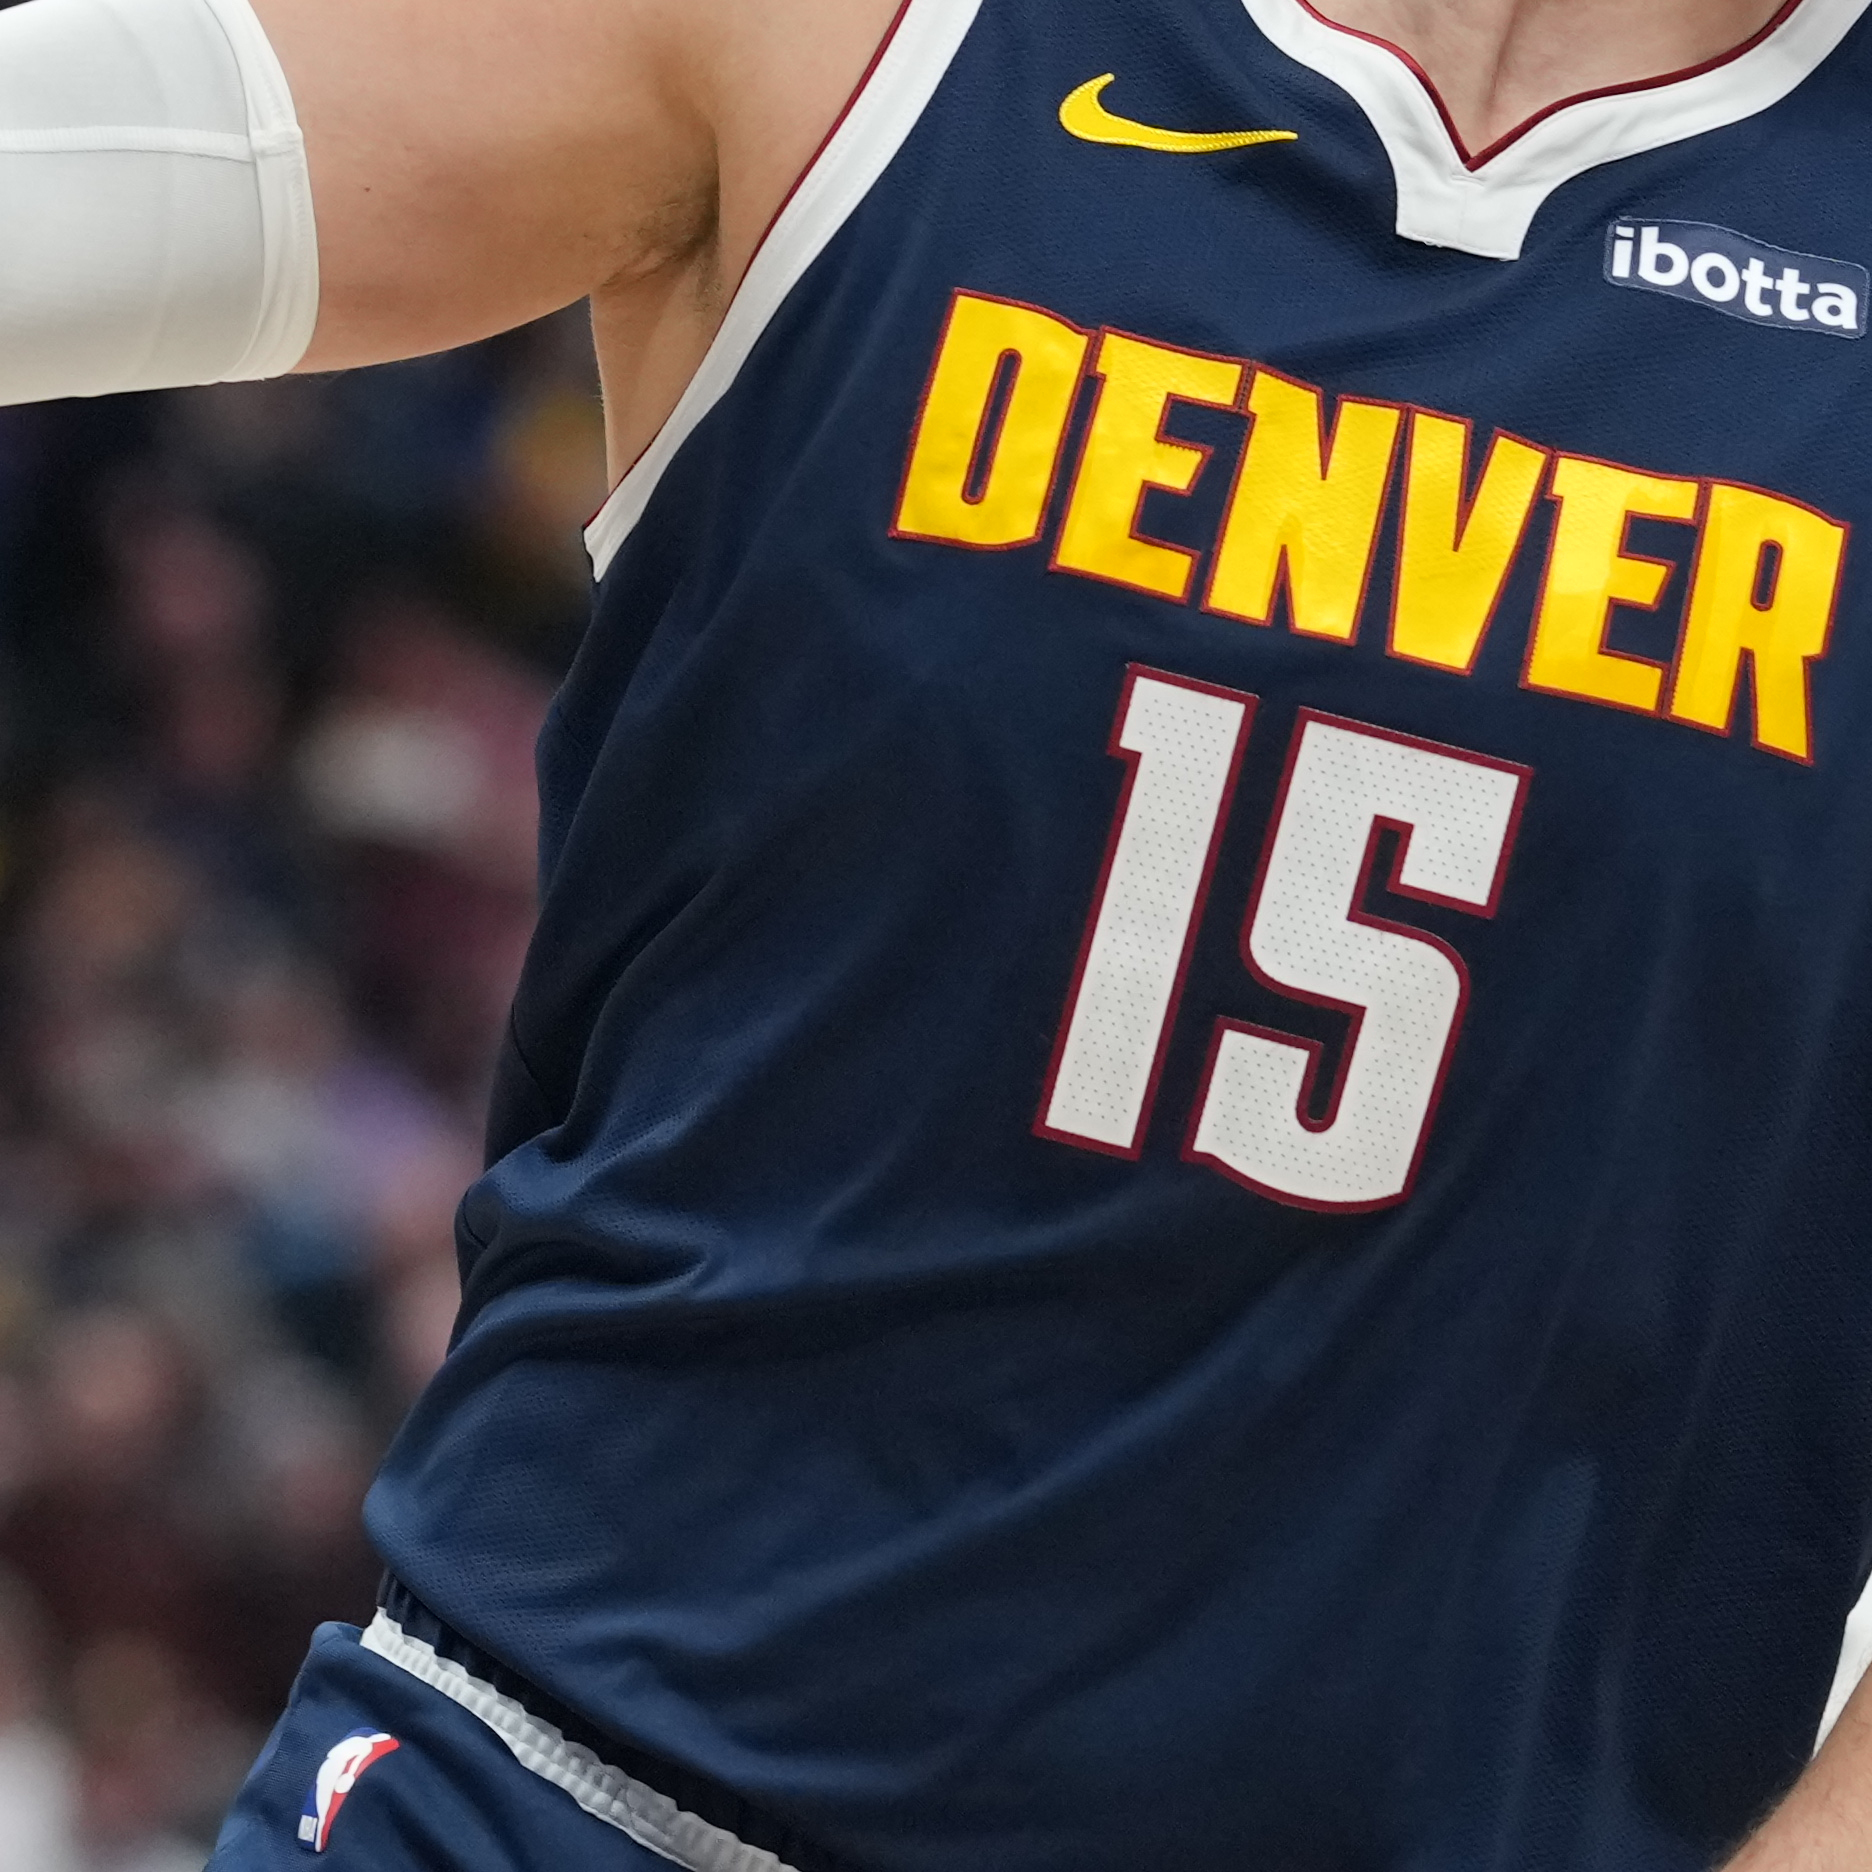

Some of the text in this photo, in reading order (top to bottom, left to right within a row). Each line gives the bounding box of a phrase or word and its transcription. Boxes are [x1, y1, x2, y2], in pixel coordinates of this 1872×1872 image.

[1612, 225, 1858, 330] ibotta
[890, 288, 1850, 766] DENVER
[1034, 665, 1534, 1211] 15
